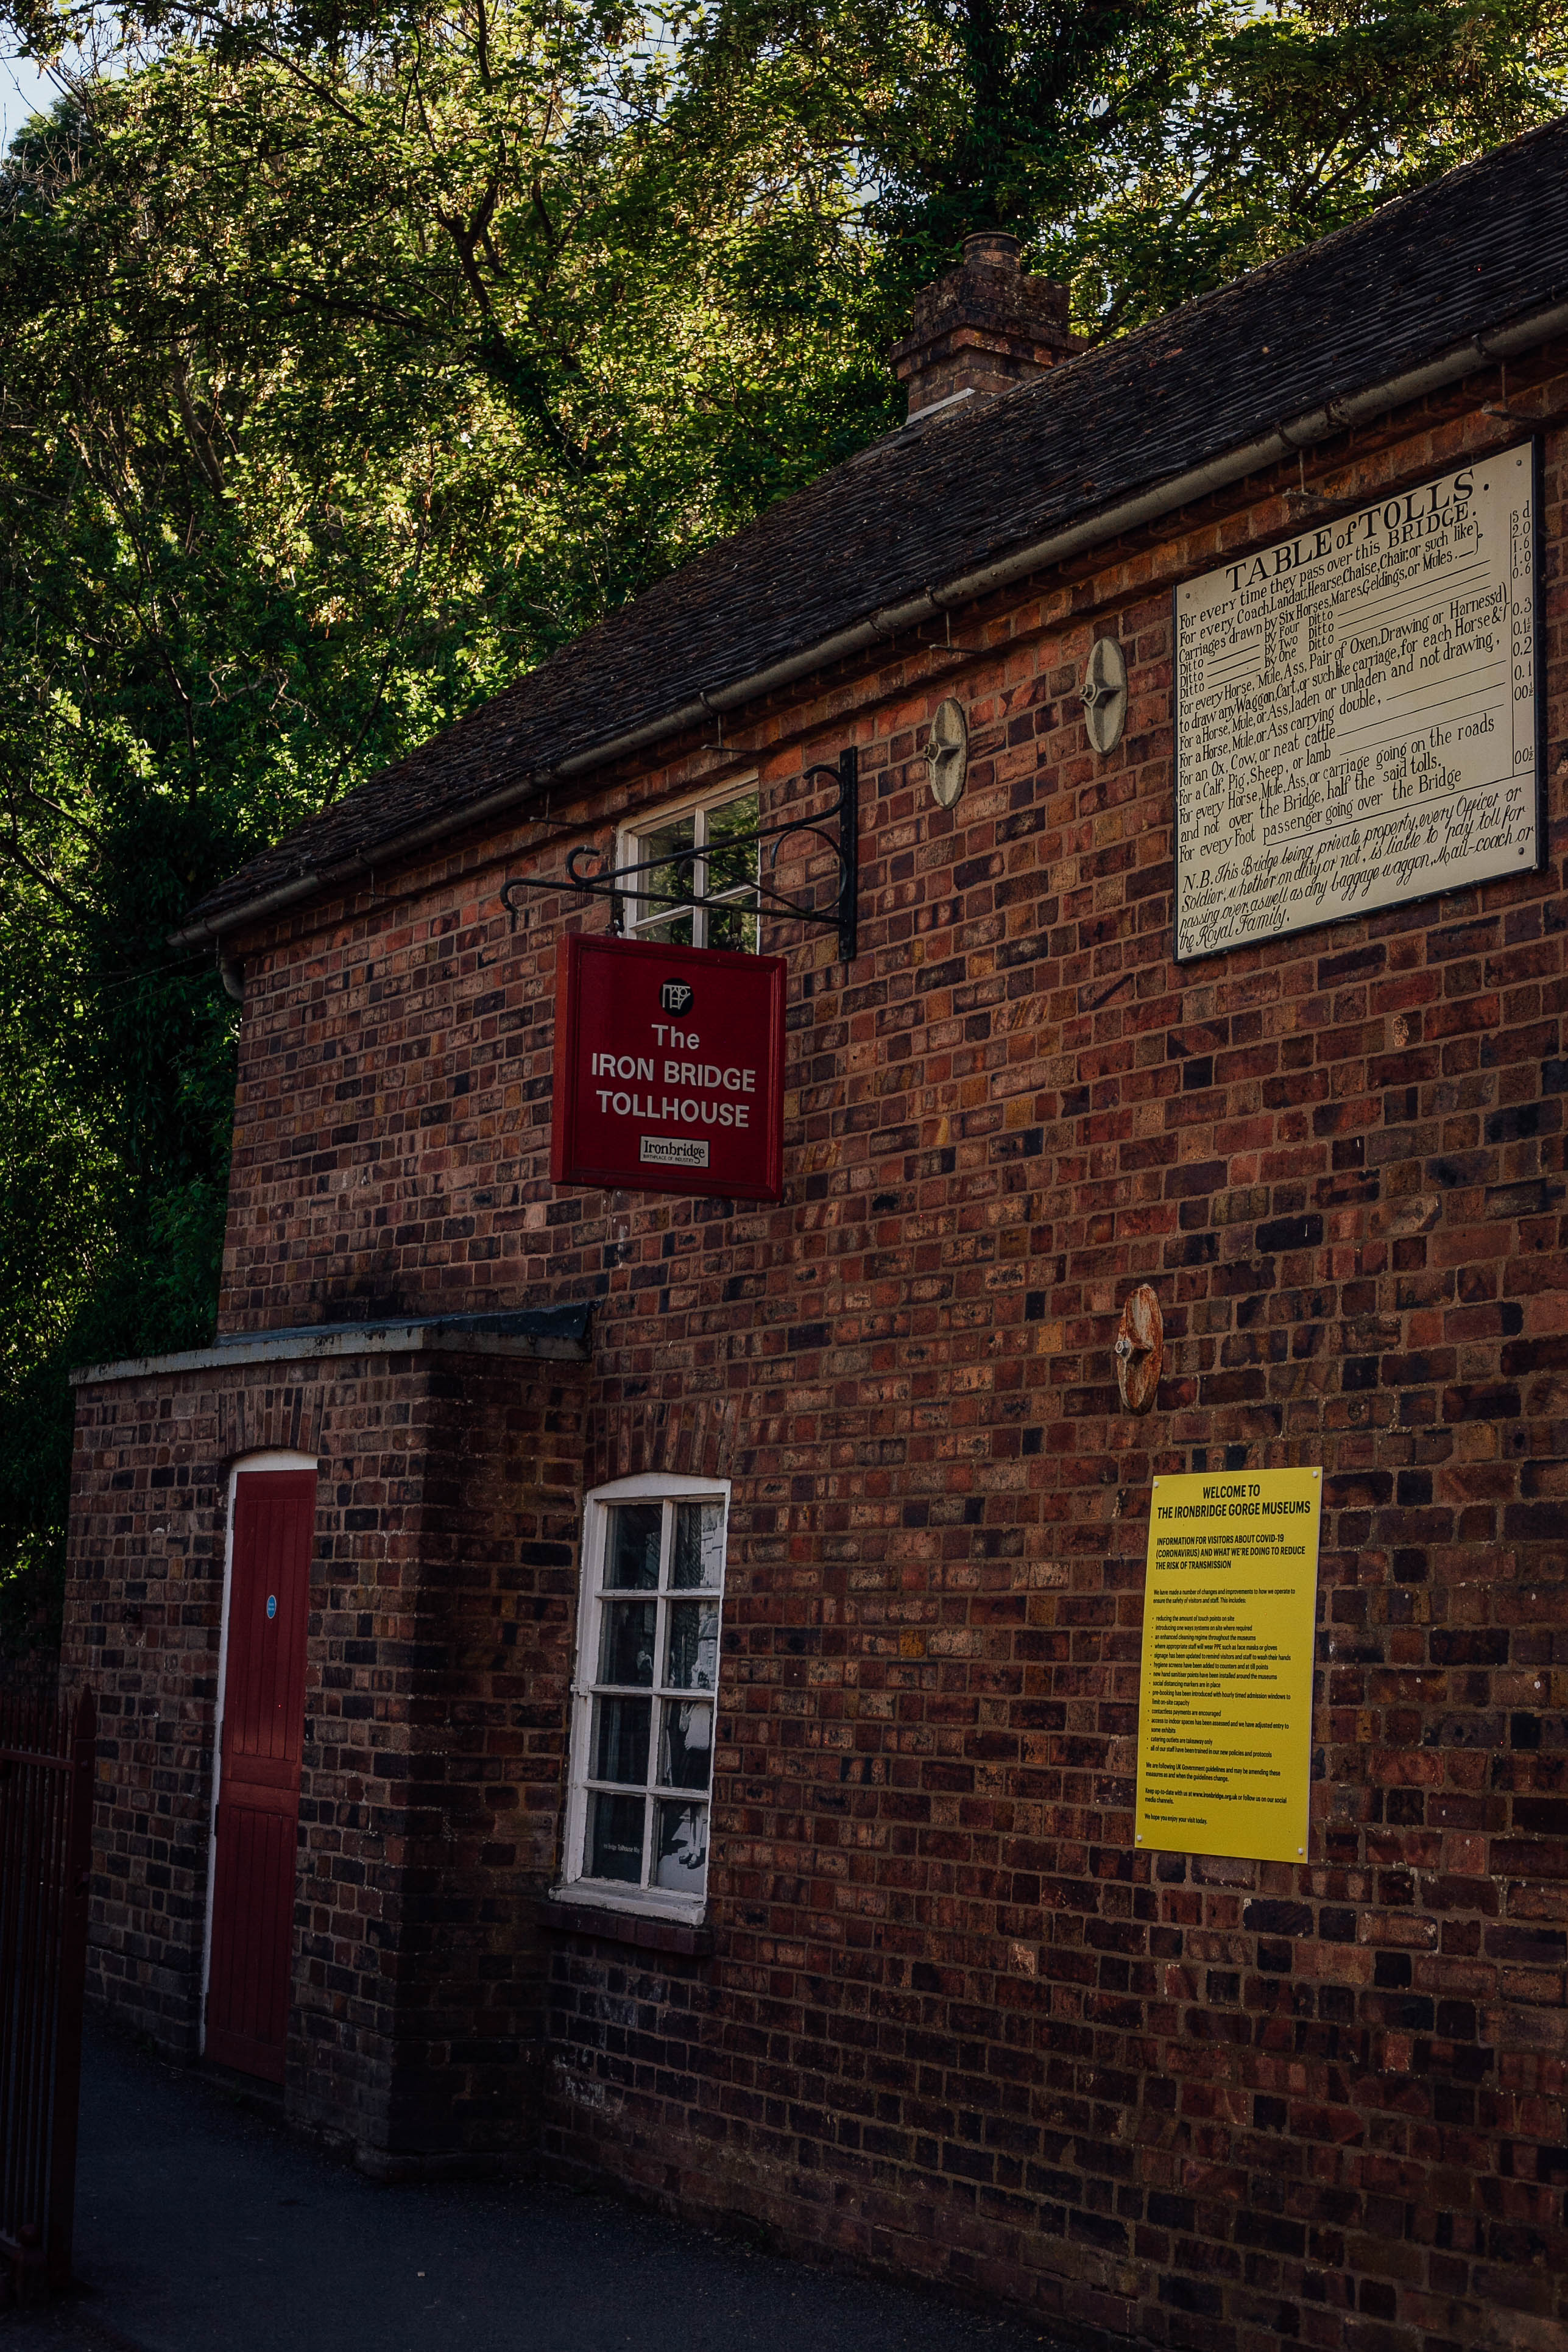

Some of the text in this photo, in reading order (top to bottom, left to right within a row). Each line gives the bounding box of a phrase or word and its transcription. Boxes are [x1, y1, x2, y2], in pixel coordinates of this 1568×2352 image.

[1511, 520, 1531, 539] 2.0
[1513, 535, 1530, 553] 1.6
[1226, 528, 1332, 592] TABLE
[1335, 520, 1357, 549] of
[1512, 562, 1531, 579] 0.6
[1513, 549, 1531, 567] 1.0
[1179, 613, 1196, 631] For
[1240, 587, 1267, 606] time
[1270, 574, 1297, 595] they
[1299, 563, 1325, 588] pass
[1326, 553, 1353, 572] over
[1355, 540, 1380, 561] this
[1512, 596, 1532, 616] 0.3
[1179, 610, 1333, 676] Ditto by Four Ditto
[1179, 623, 1334, 688] Ditto by Two Ditto
[1512, 635, 1532, 657] 0.2
[1179, 634, 1334, 700] Ditto by One Ditto
[1513, 660, 1532, 680] 0.1
[1179, 689, 1381, 769] For a Horse, Mule, or Ass carrying double,
[1179, 724, 1335, 788] For an Ox, Cow, or neat cattle
[1179, 712, 1494, 825] For every Horse, Mule, Ass, or carriage going on the roads
[1178, 743, 1331, 807] For a Calf, Pig, Sheep, or lamb
[1180, 751, 1441, 843] and not over the Bridge, half the said tolls.
[1179, 768, 1461, 863] For every Foot passenger going over the Bridge
[1179, 905, 1290, 950] the Royal Family.
[651, 1023, 700, 1050] The
[591, 1053, 756, 1092] IRON BRIDGE
[596, 1090, 750, 1128] TOLLHOUSE
[644, 1140, 705, 1164] Ironbridge
[1202, 1484, 1260, 1499] WELCOME TO
[1157, 1500, 1311, 1519] THE IRONBRIDGE GORGE MUSEUMS
[1156, 1548, 1200, 1559] (CORONAVIRUS)
[1200, 1549, 1213, 1557] AND
[1213, 1548, 1231, 1556] WHAT
[1250, 1547, 1270, 1556] DOING
[1271, 1546, 1279, 1555] TO
[1280, 1545, 1305, 1555] REDUCE
[1157, 1533, 1284, 1546] INFORMATION FOR VISITORS ABOUT COVID-19
[1155, 1560, 1232, 1570] THE RISK OF TRANSMISSION
